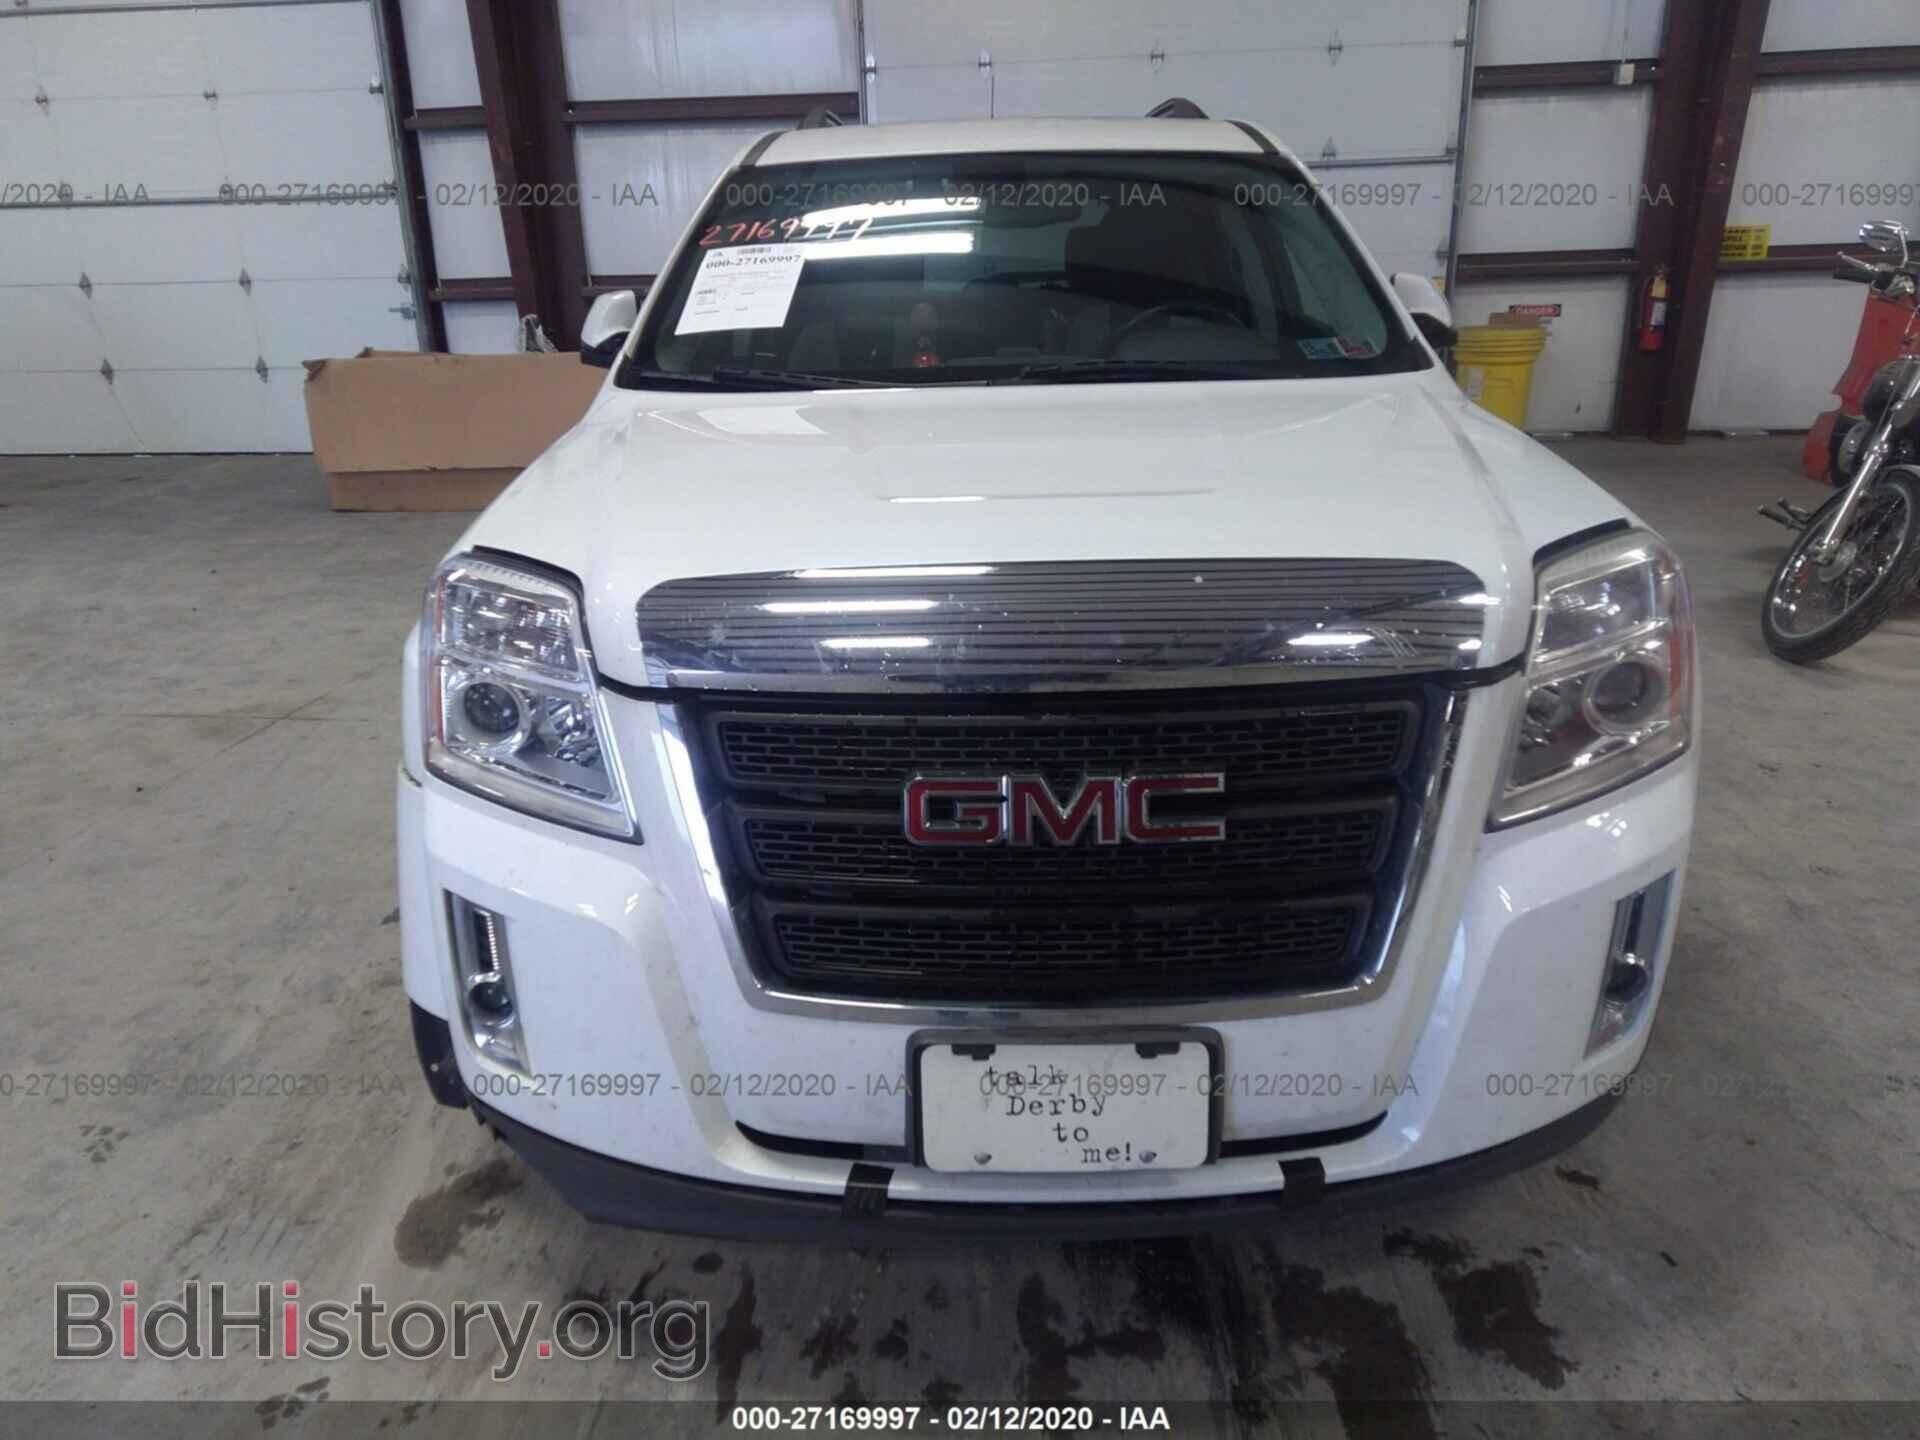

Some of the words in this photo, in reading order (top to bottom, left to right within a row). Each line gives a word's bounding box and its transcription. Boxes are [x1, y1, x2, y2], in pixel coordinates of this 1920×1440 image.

[904, 772, 1226, 845] GMC
[987, 1064, 1068, 1087] talk
[1006, 1093, 1106, 1117] Derby
[1052, 1122, 1089, 1143] to
[1080, 1142, 1131, 1164] me!
